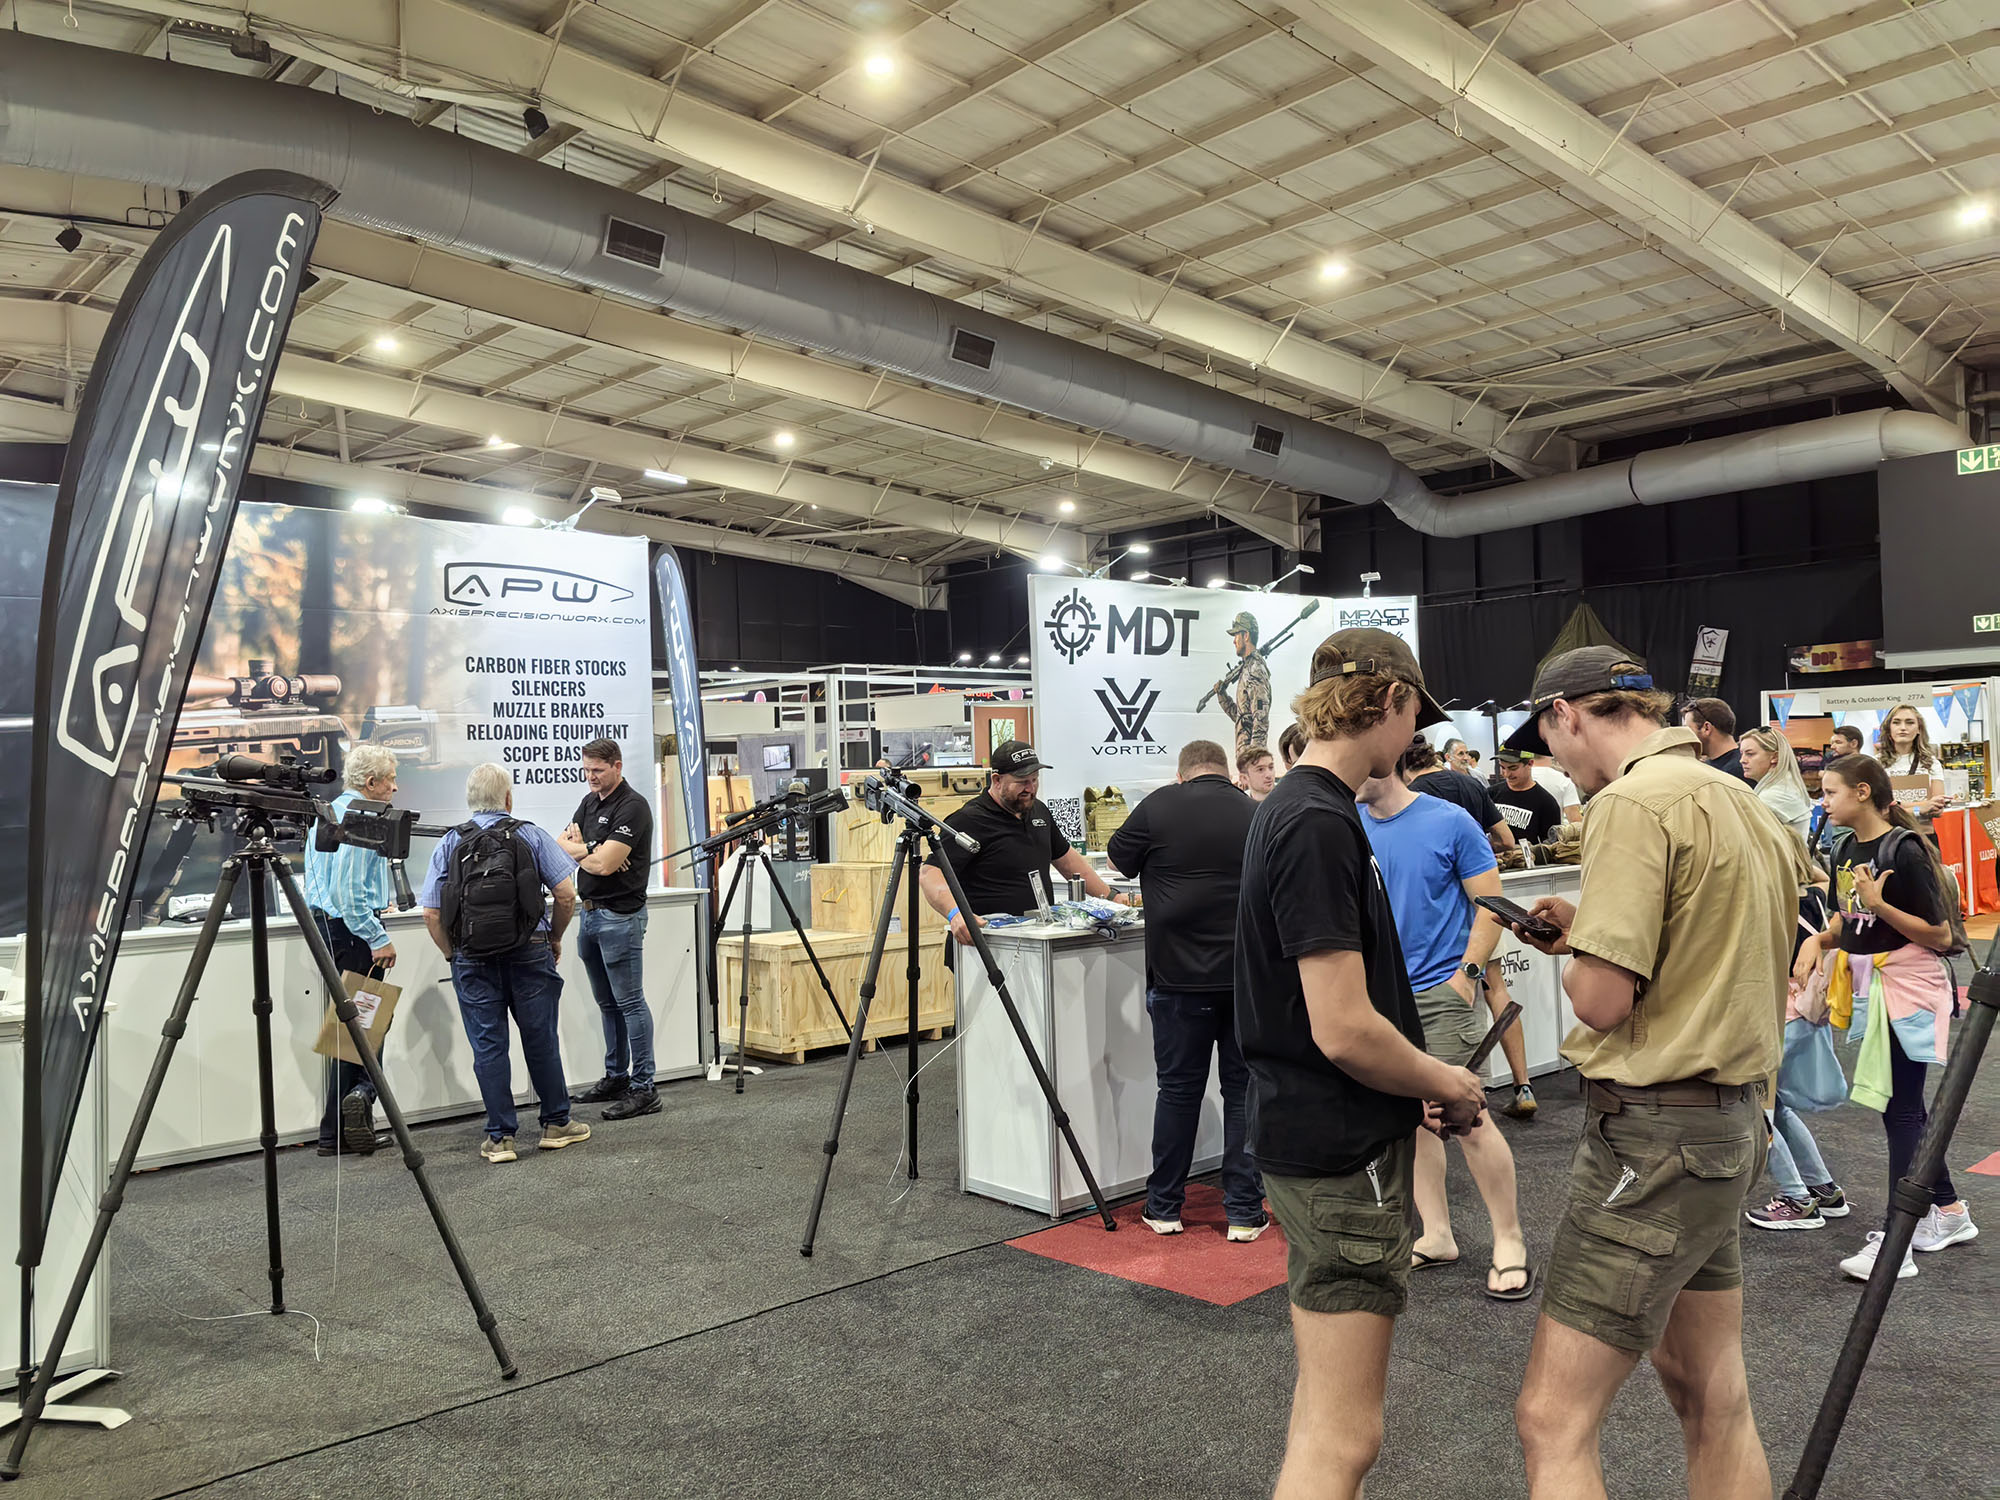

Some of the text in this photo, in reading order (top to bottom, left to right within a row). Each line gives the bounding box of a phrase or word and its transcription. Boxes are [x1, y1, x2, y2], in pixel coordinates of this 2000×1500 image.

[452, 574, 598, 603] APW
[429, 607, 646, 625] AXISPRECISIONWORX.COM
[1339, 607, 1410, 620] IMPACT
[1106, 604, 1200, 657] MDT
[1339, 617, 1410, 628] PROSHOP
[465, 656, 627, 676] CARBON FIBER STOCKS
[511, 680, 587, 697] SILENCERS
[1826, 697, 1850, 706] Battery
[1857, 696, 1886, 704] Outdoor
[1886, 695, 1902, 704] King
[1907, 693, 1925, 701] 277A
[493, 702, 605, 719] MUZZLE BRAKES
[467, 724, 630, 743] RELOADING EQUIPMENT
[503, 746, 584, 762] SCOPE BAS
[1091, 745, 1168, 755] VORTEX
[525, 768, 587, 785] ACCESSO
